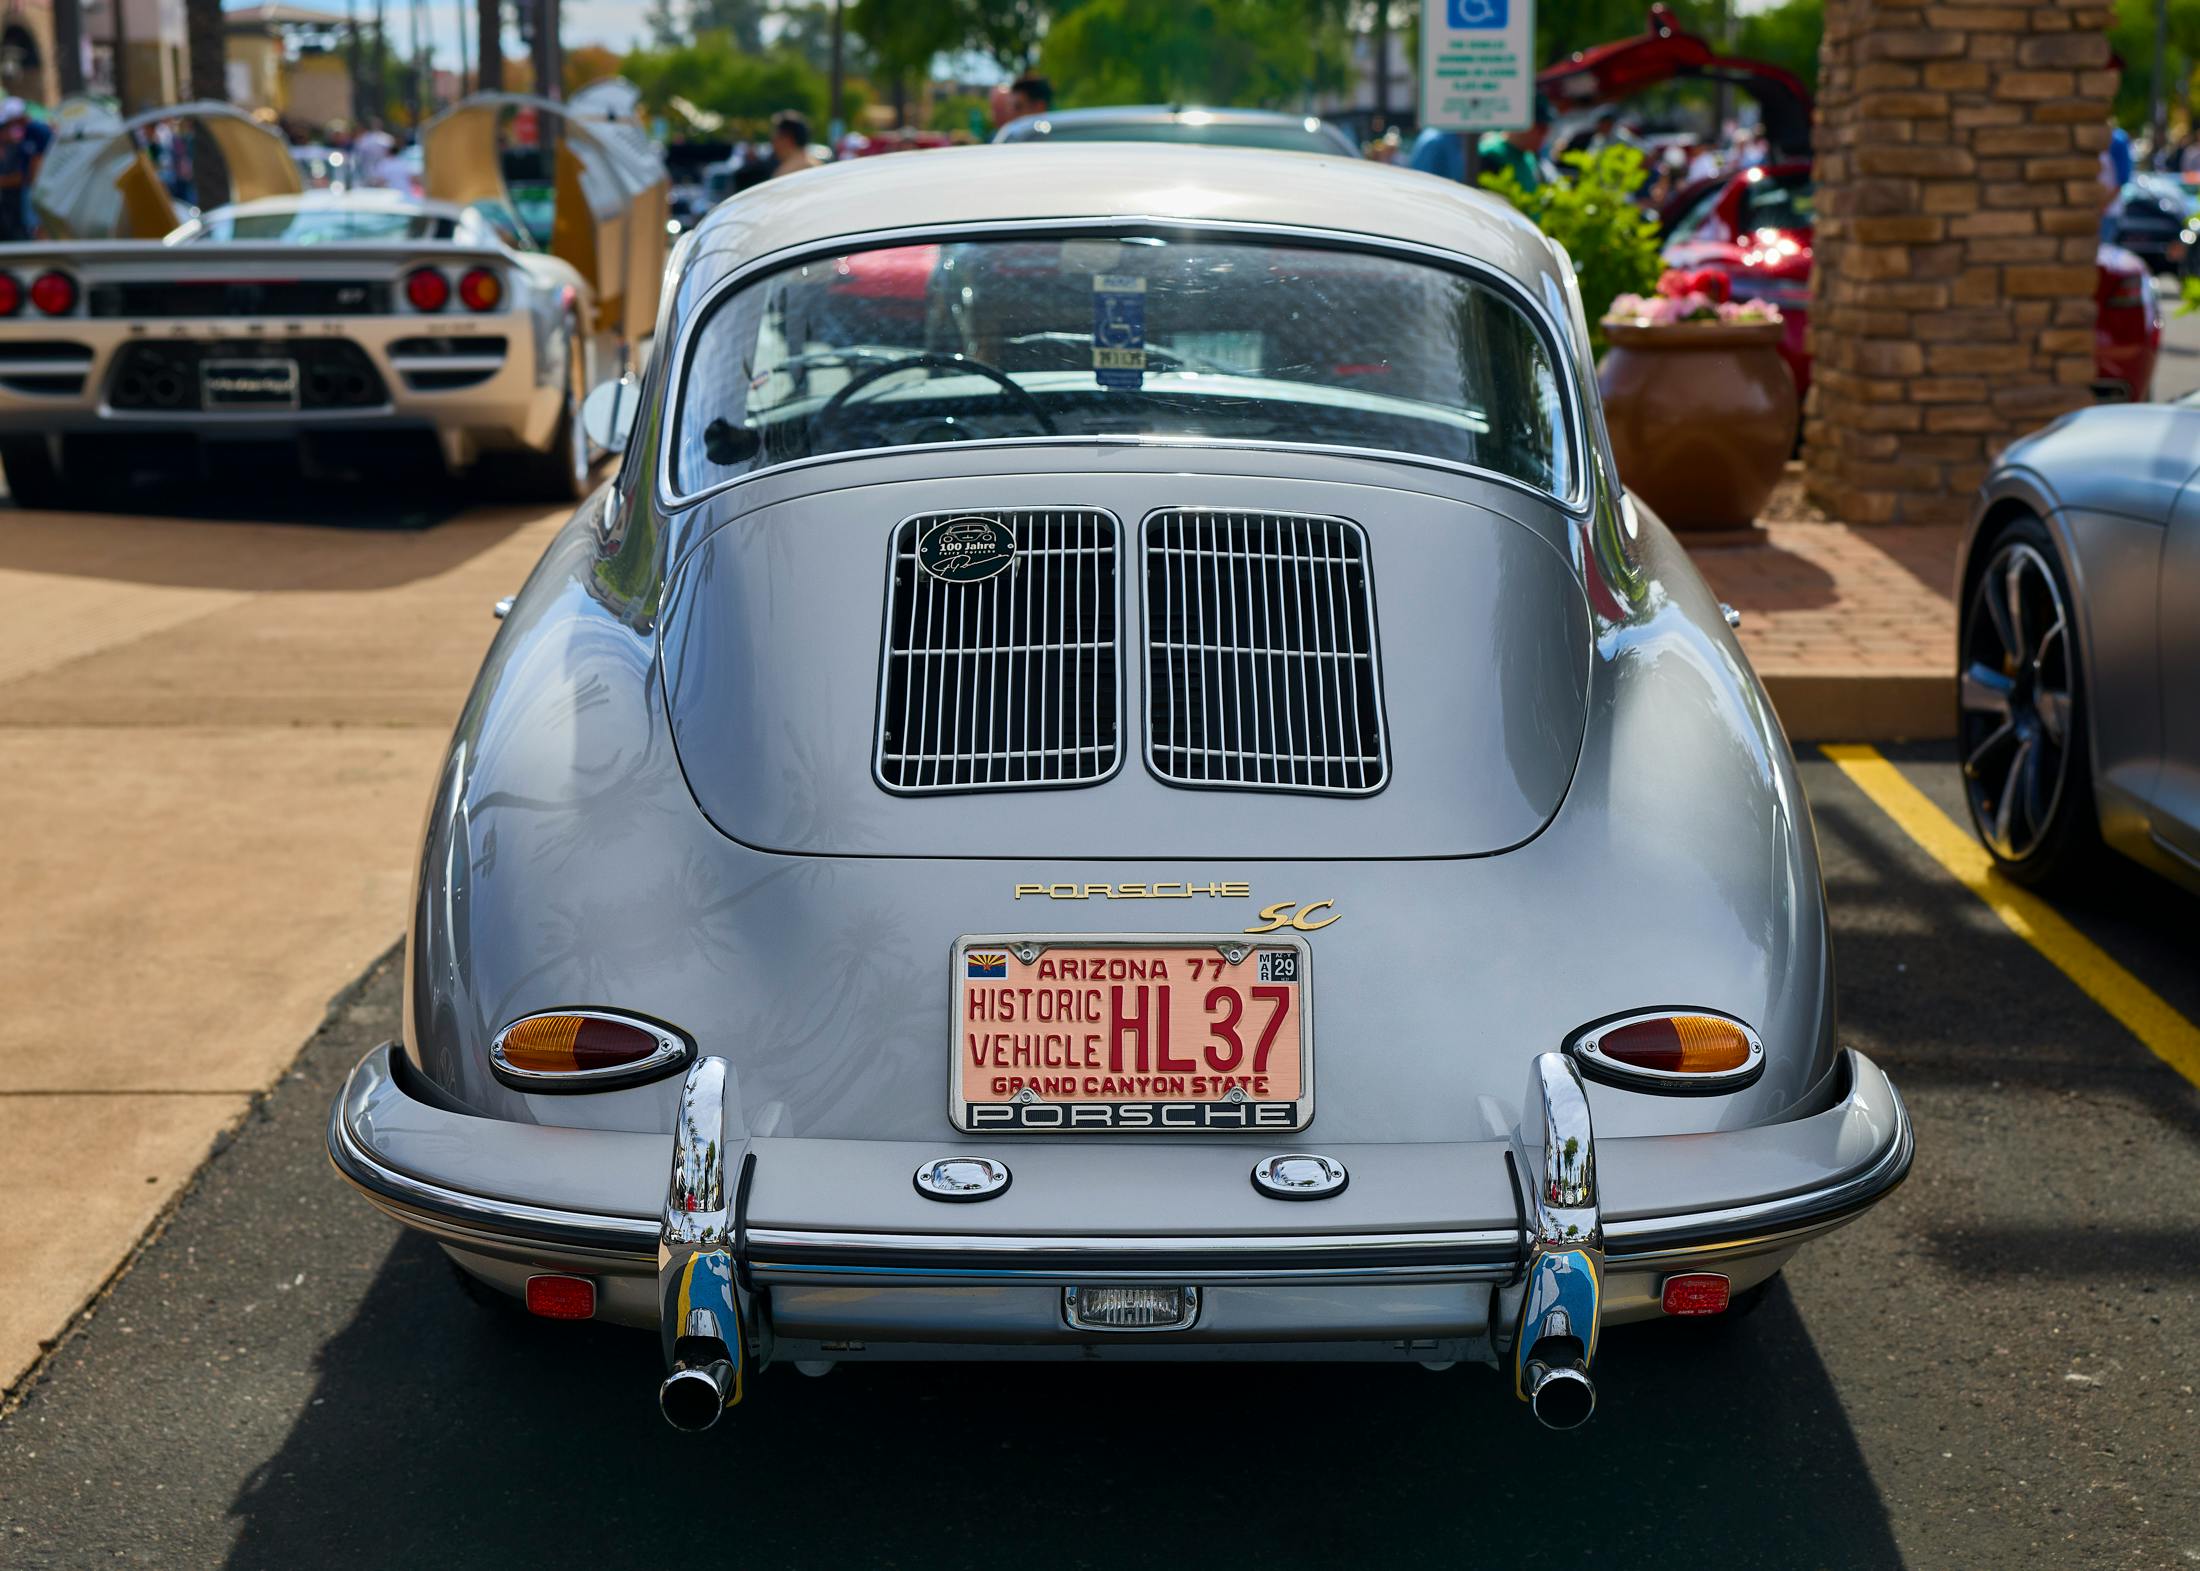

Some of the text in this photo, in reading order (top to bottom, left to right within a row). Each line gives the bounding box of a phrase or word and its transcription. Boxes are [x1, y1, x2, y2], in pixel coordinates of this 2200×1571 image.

[939, 542, 996, 551] 100 Jahre
[1014, 881, 1250, 900] PORSCHE
[1244, 898, 1342, 933] SC
[1038, 959, 1227, 980] ARIZONA 77
[1260, 954, 1270, 981] MAR
[1275, 959, 1295, 976] 29
[969, 988, 1102, 1022] HISTORIC
[1112, 985, 1290, 1073] HL37
[969, 1034, 1101, 1067] VEHICLE
[991, 1076, 1269, 1094] GRAND CANYON STATE
[972, 1104, 1291, 1127] PORSCHE
